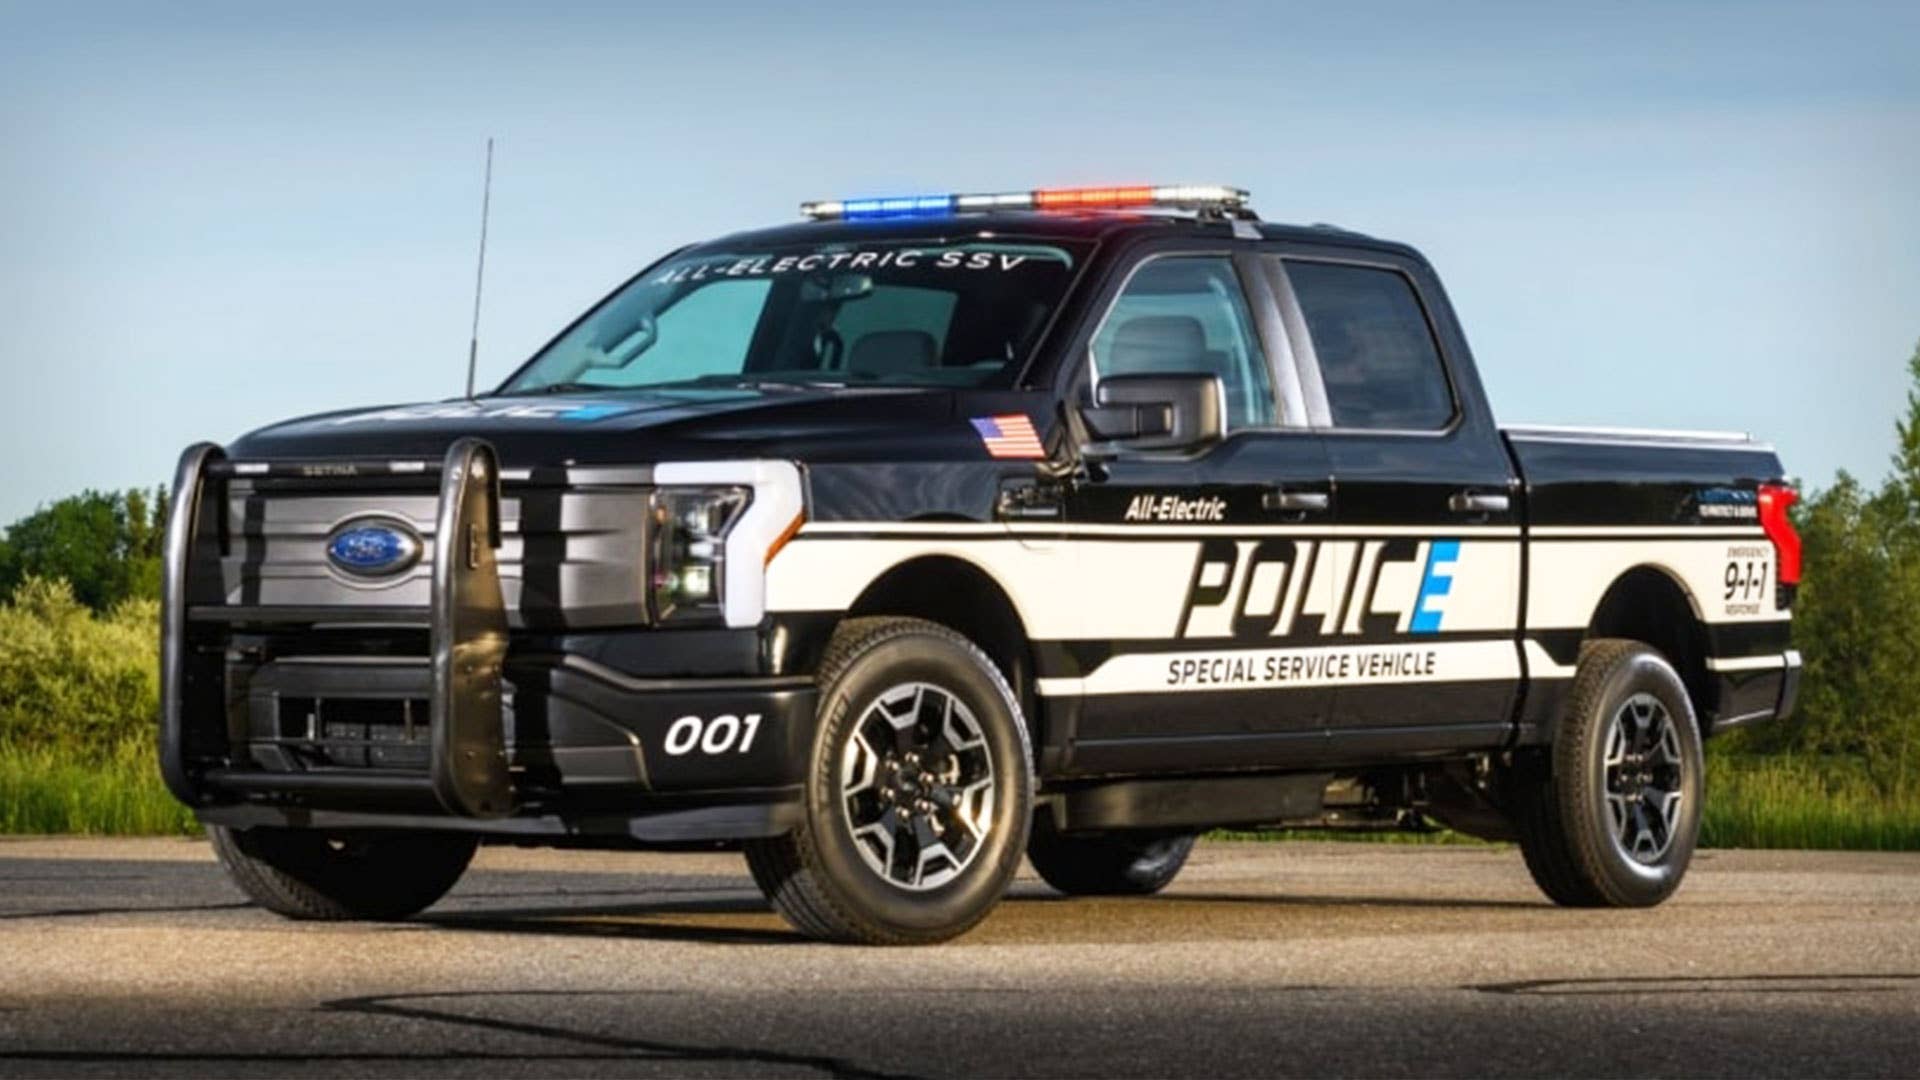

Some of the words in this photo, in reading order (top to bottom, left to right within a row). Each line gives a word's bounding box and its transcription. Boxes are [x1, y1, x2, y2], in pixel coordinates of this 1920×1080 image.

[652, 250, 923, 284] ALL-ELECTRIC
[936, 251, 1025, 271] SSV
[1125, 496, 1227, 520] All-Electric
[1174, 540, 1460, 638] POLICE
[1724, 562, 1767, 600] 9-1-1
[1167, 658, 1256, 684] SPECIAL
[1264, 654, 1349, 681] SERVICE
[1357, 651, 1435, 676] VEHICLE
[664, 714, 762, 755] 001
